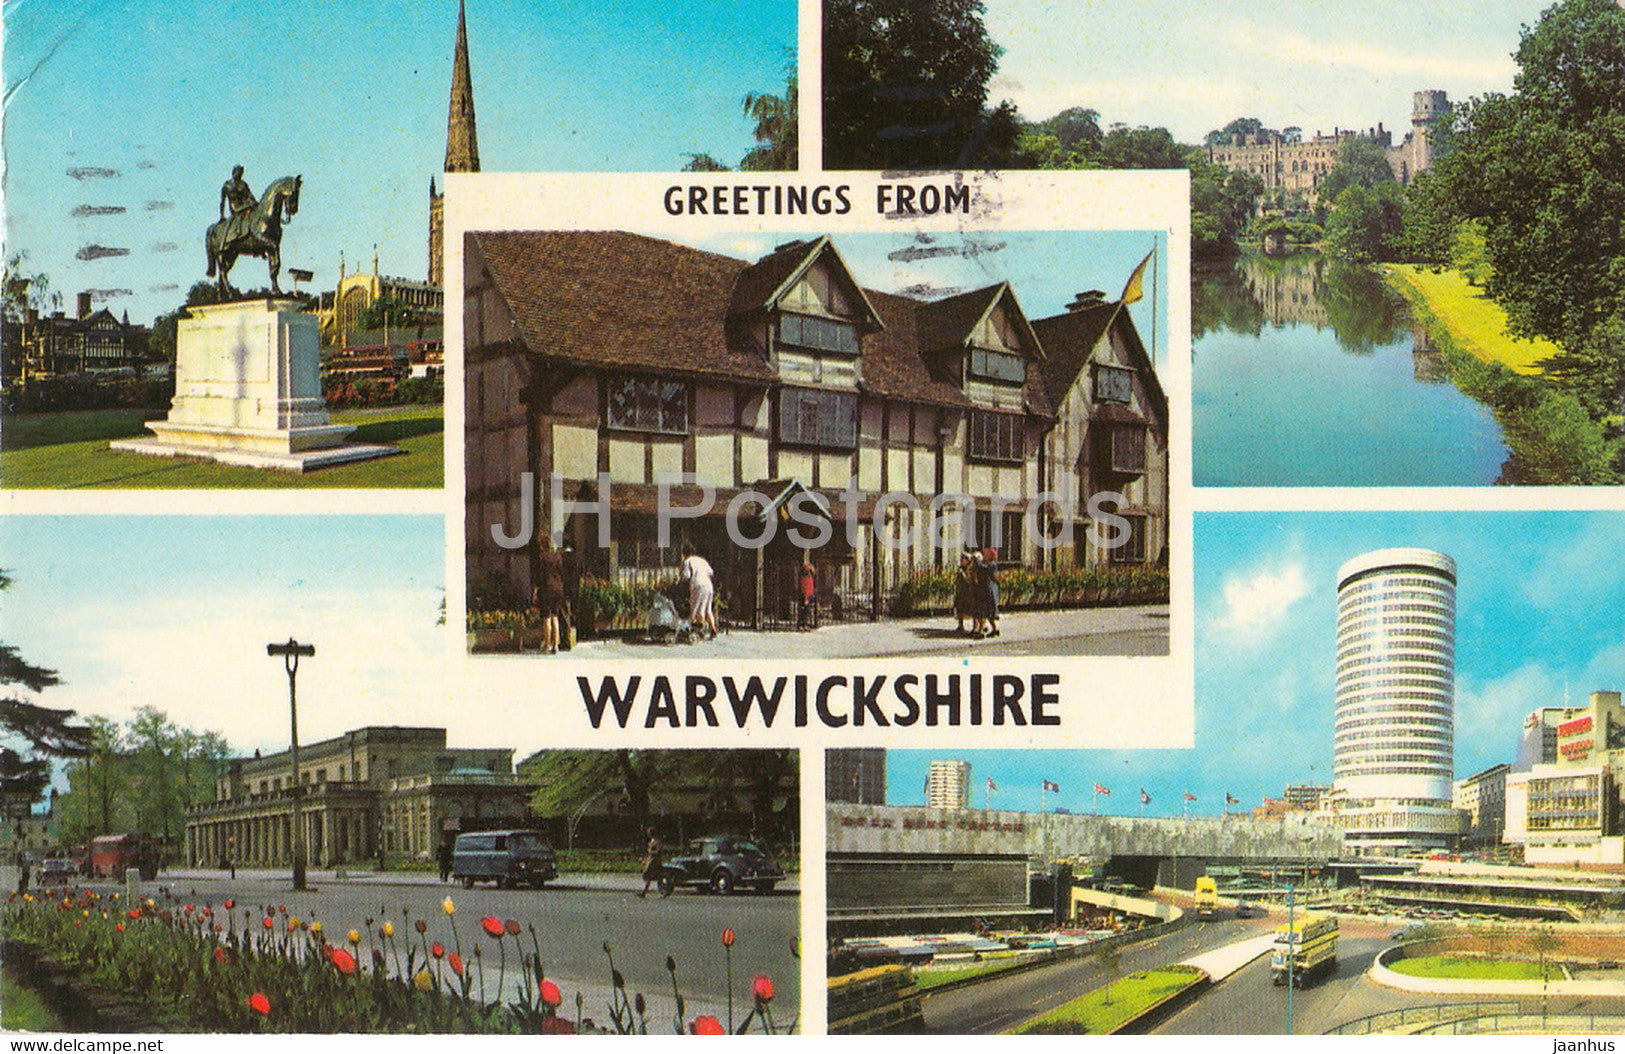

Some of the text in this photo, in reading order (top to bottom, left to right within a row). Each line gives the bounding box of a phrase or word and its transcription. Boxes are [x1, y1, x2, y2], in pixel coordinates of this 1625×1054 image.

[664, 185, 970, 216] GREETINGS FROM
[576, 673, 1061, 729] WARWICKSHIRE
